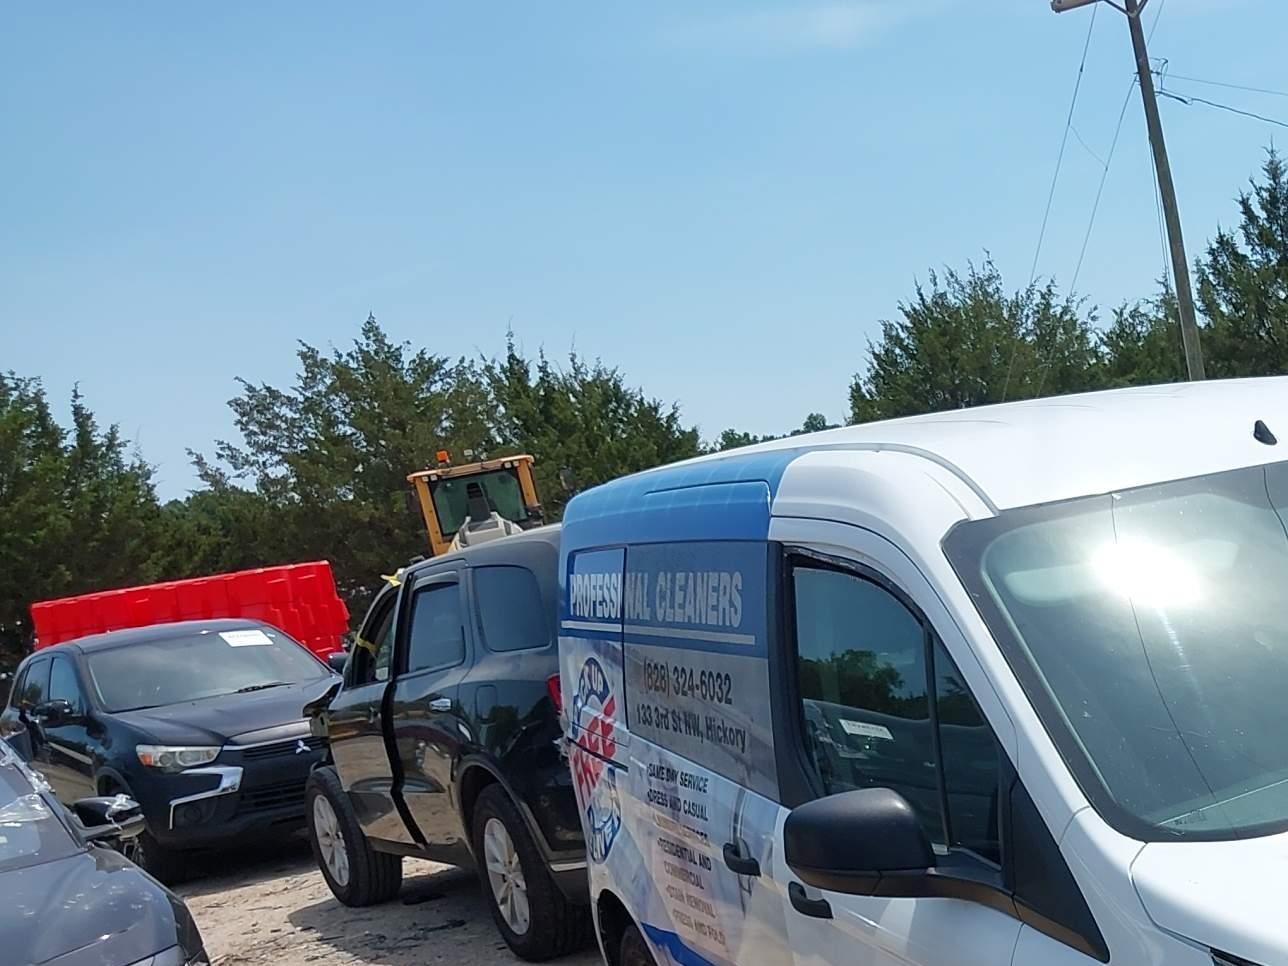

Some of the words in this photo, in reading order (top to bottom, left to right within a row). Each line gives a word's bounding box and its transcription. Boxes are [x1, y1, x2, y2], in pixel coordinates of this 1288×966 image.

[570, 572, 651, 621] PROFESSINAL
[656, 571, 743, 628] CLEANERS
[643, 656, 670, 697] (828)
[672, 665, 733, 706] 324-6032
[637, 703, 653, 728] 133
[654, 706, 670, 731] 3rd
[671, 709, 683, 735] St
[704, 716, 746, 755] Hickory
[679, 771, 709, 794] SERVICE
[683, 799, 709, 822] CASUAL
